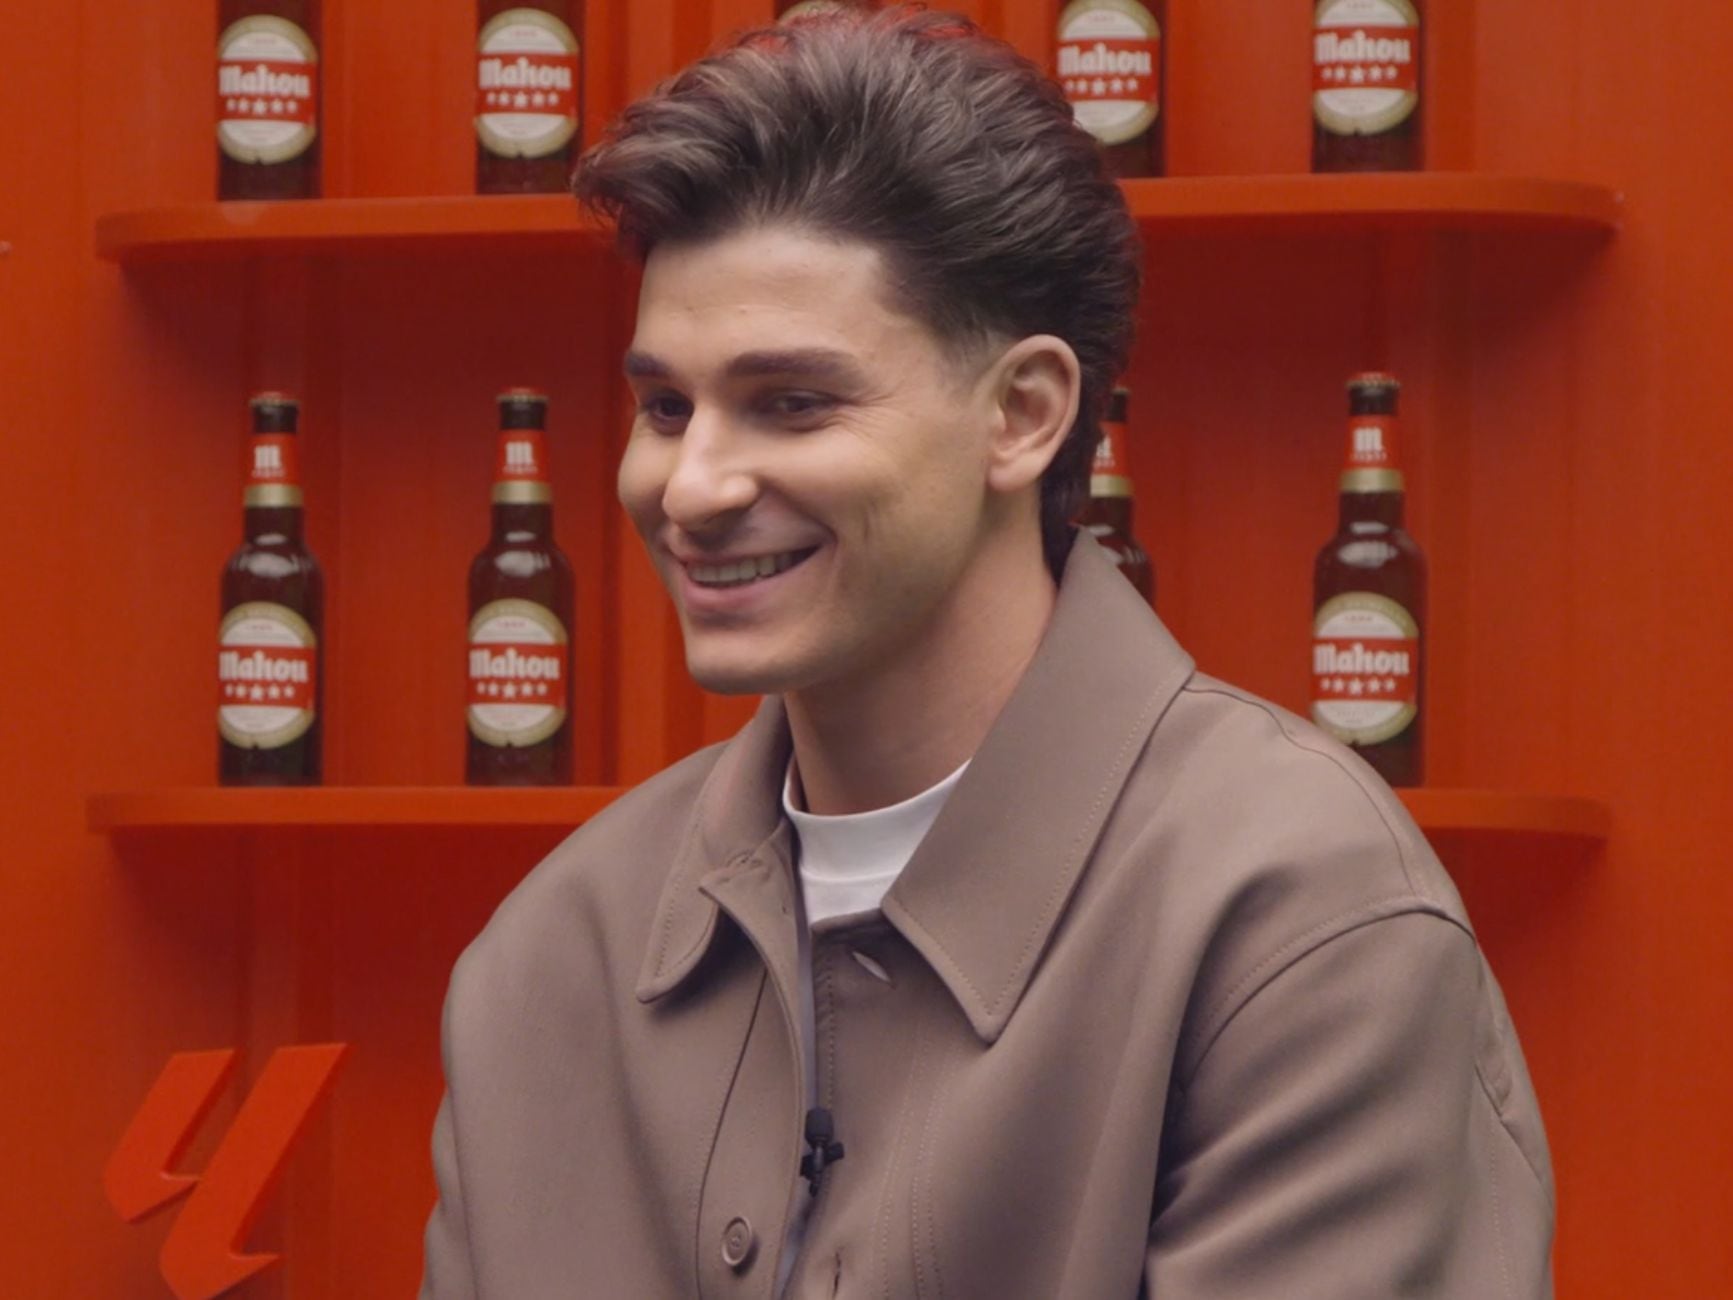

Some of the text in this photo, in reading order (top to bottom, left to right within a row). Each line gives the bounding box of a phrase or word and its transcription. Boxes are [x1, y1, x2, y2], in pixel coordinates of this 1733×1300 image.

[1057, 42, 1152, 77] Mahou
[1314, 29, 1411, 64] Mahou
[219, 63, 310, 98] Mahou
[478, 56, 571, 90] Mahou
[219, 649, 309, 683] Mahou
[469, 646, 560, 680] Mahou
[1313, 641, 1410, 676] Mahou
